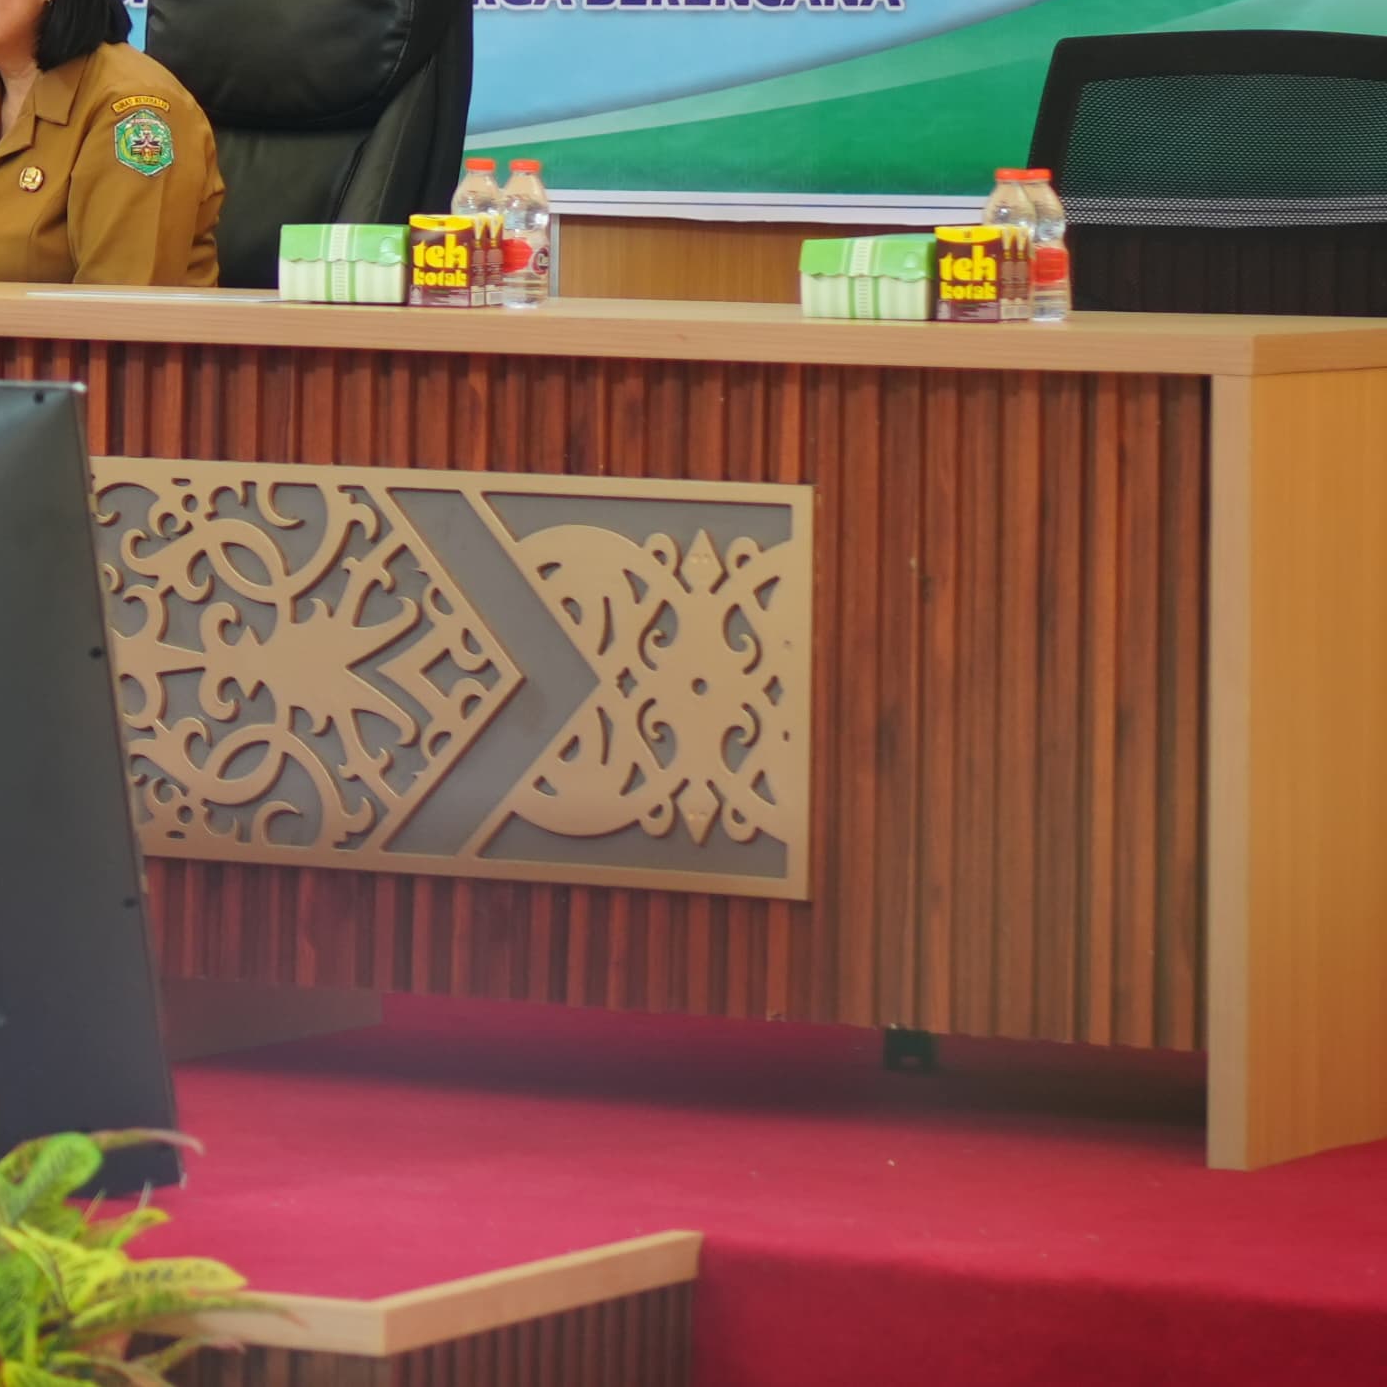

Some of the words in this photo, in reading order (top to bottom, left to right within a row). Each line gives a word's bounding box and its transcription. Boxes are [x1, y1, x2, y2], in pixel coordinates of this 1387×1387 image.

[413, 234, 468, 269] teh
[940, 244, 997, 282] teh
[413, 268, 468, 287] kotak
[940, 281, 997, 301] kotak
